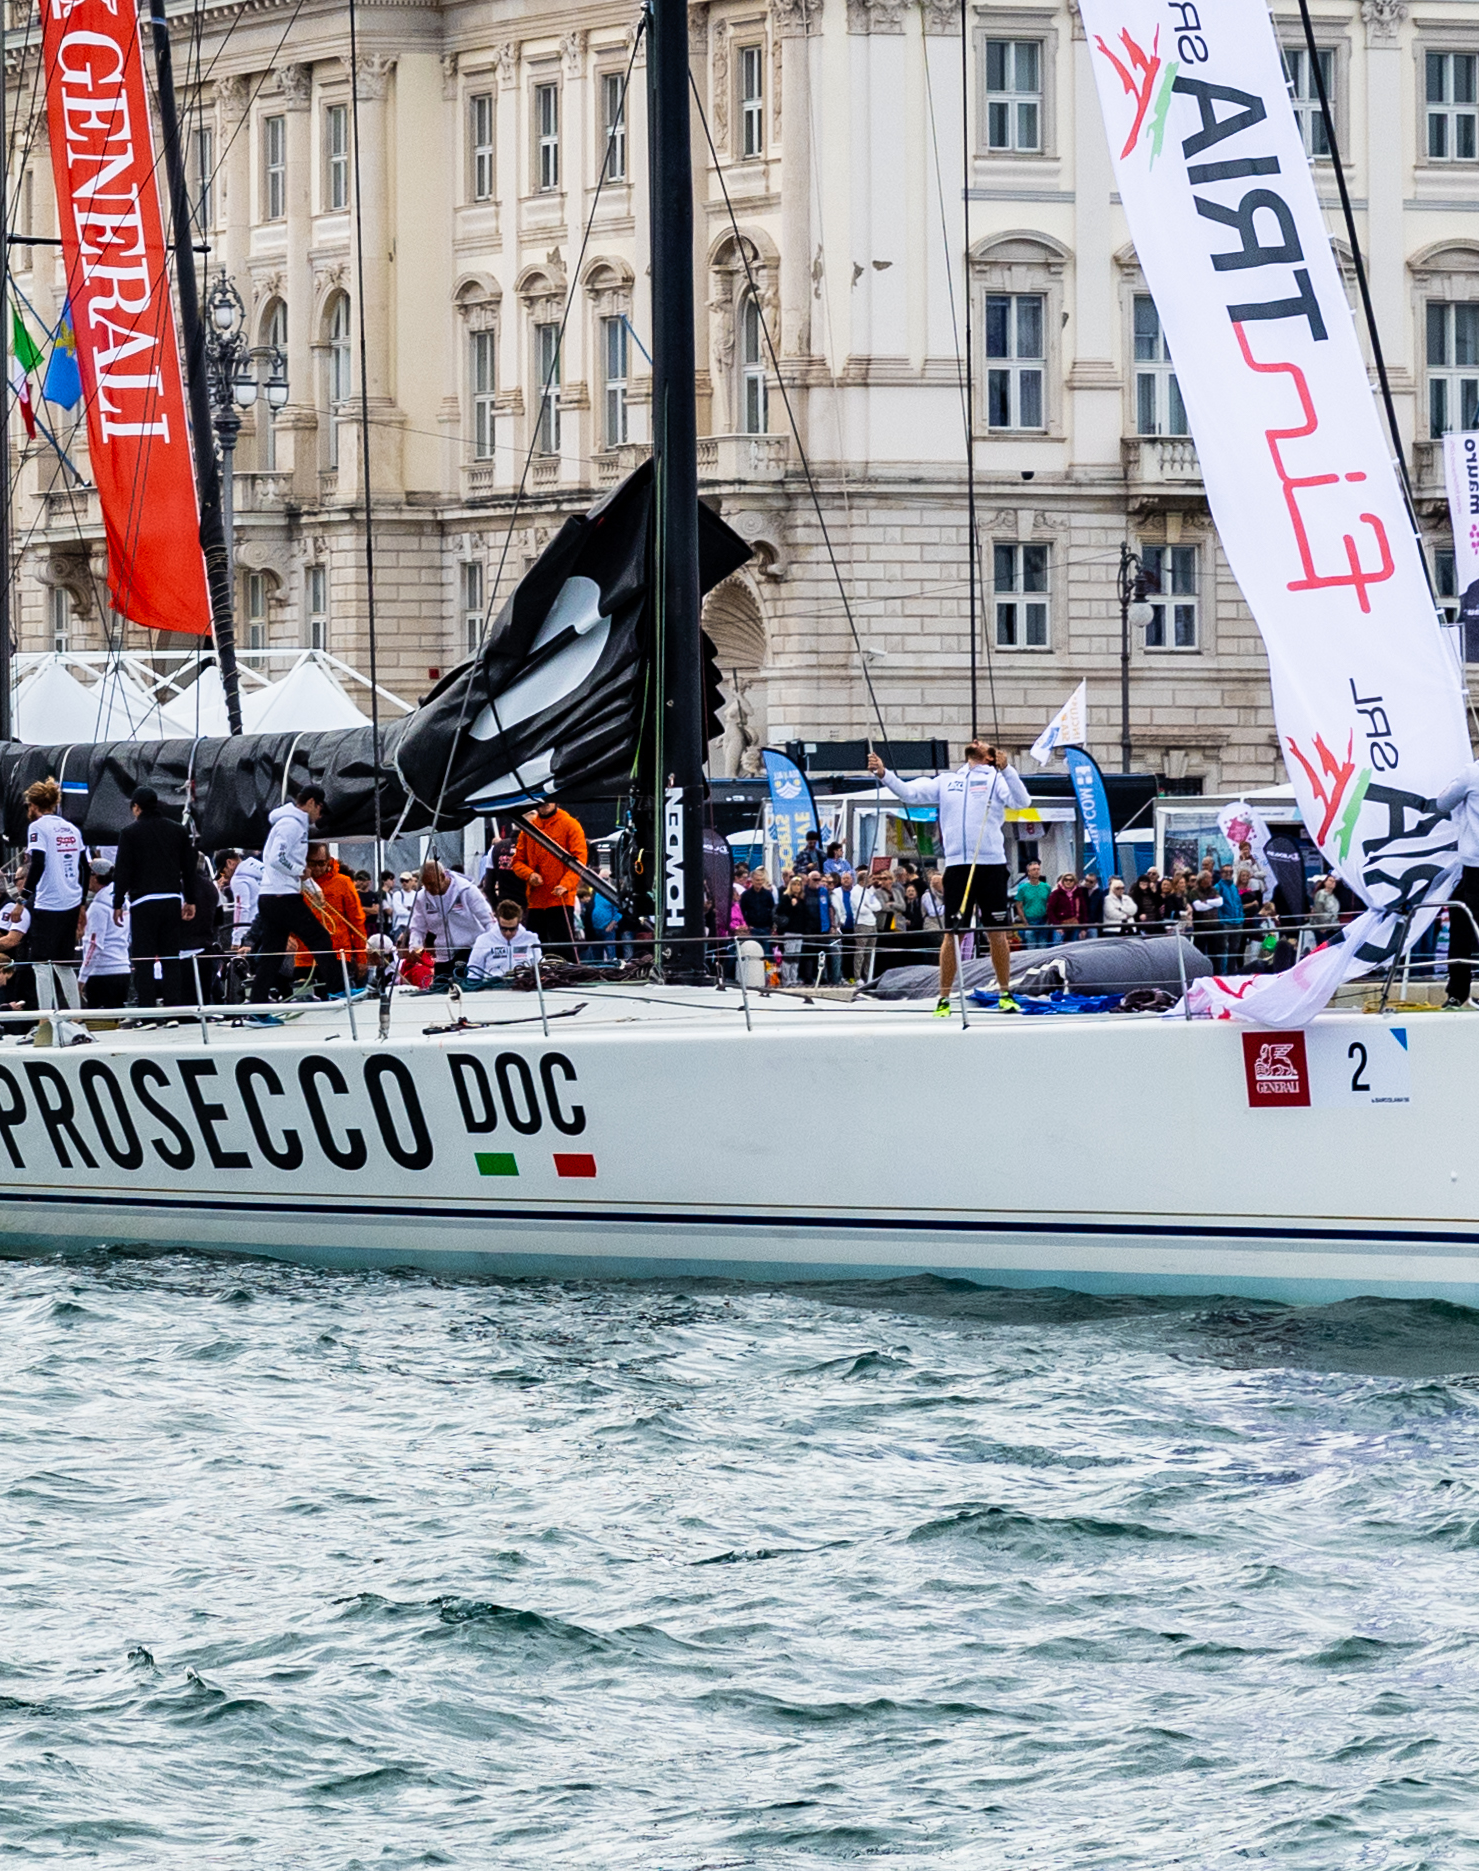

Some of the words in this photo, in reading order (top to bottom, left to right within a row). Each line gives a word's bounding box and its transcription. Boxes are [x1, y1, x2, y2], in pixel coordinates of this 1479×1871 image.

[57, 30, 170, 445] GENERALI
[664, 787, 685, 927] HOWDEN
[446, 1051, 588, 1136] DOC
[1256, 1081, 1300, 1094] GENERALI
[1348, 1042, 1371, 1092] 2
